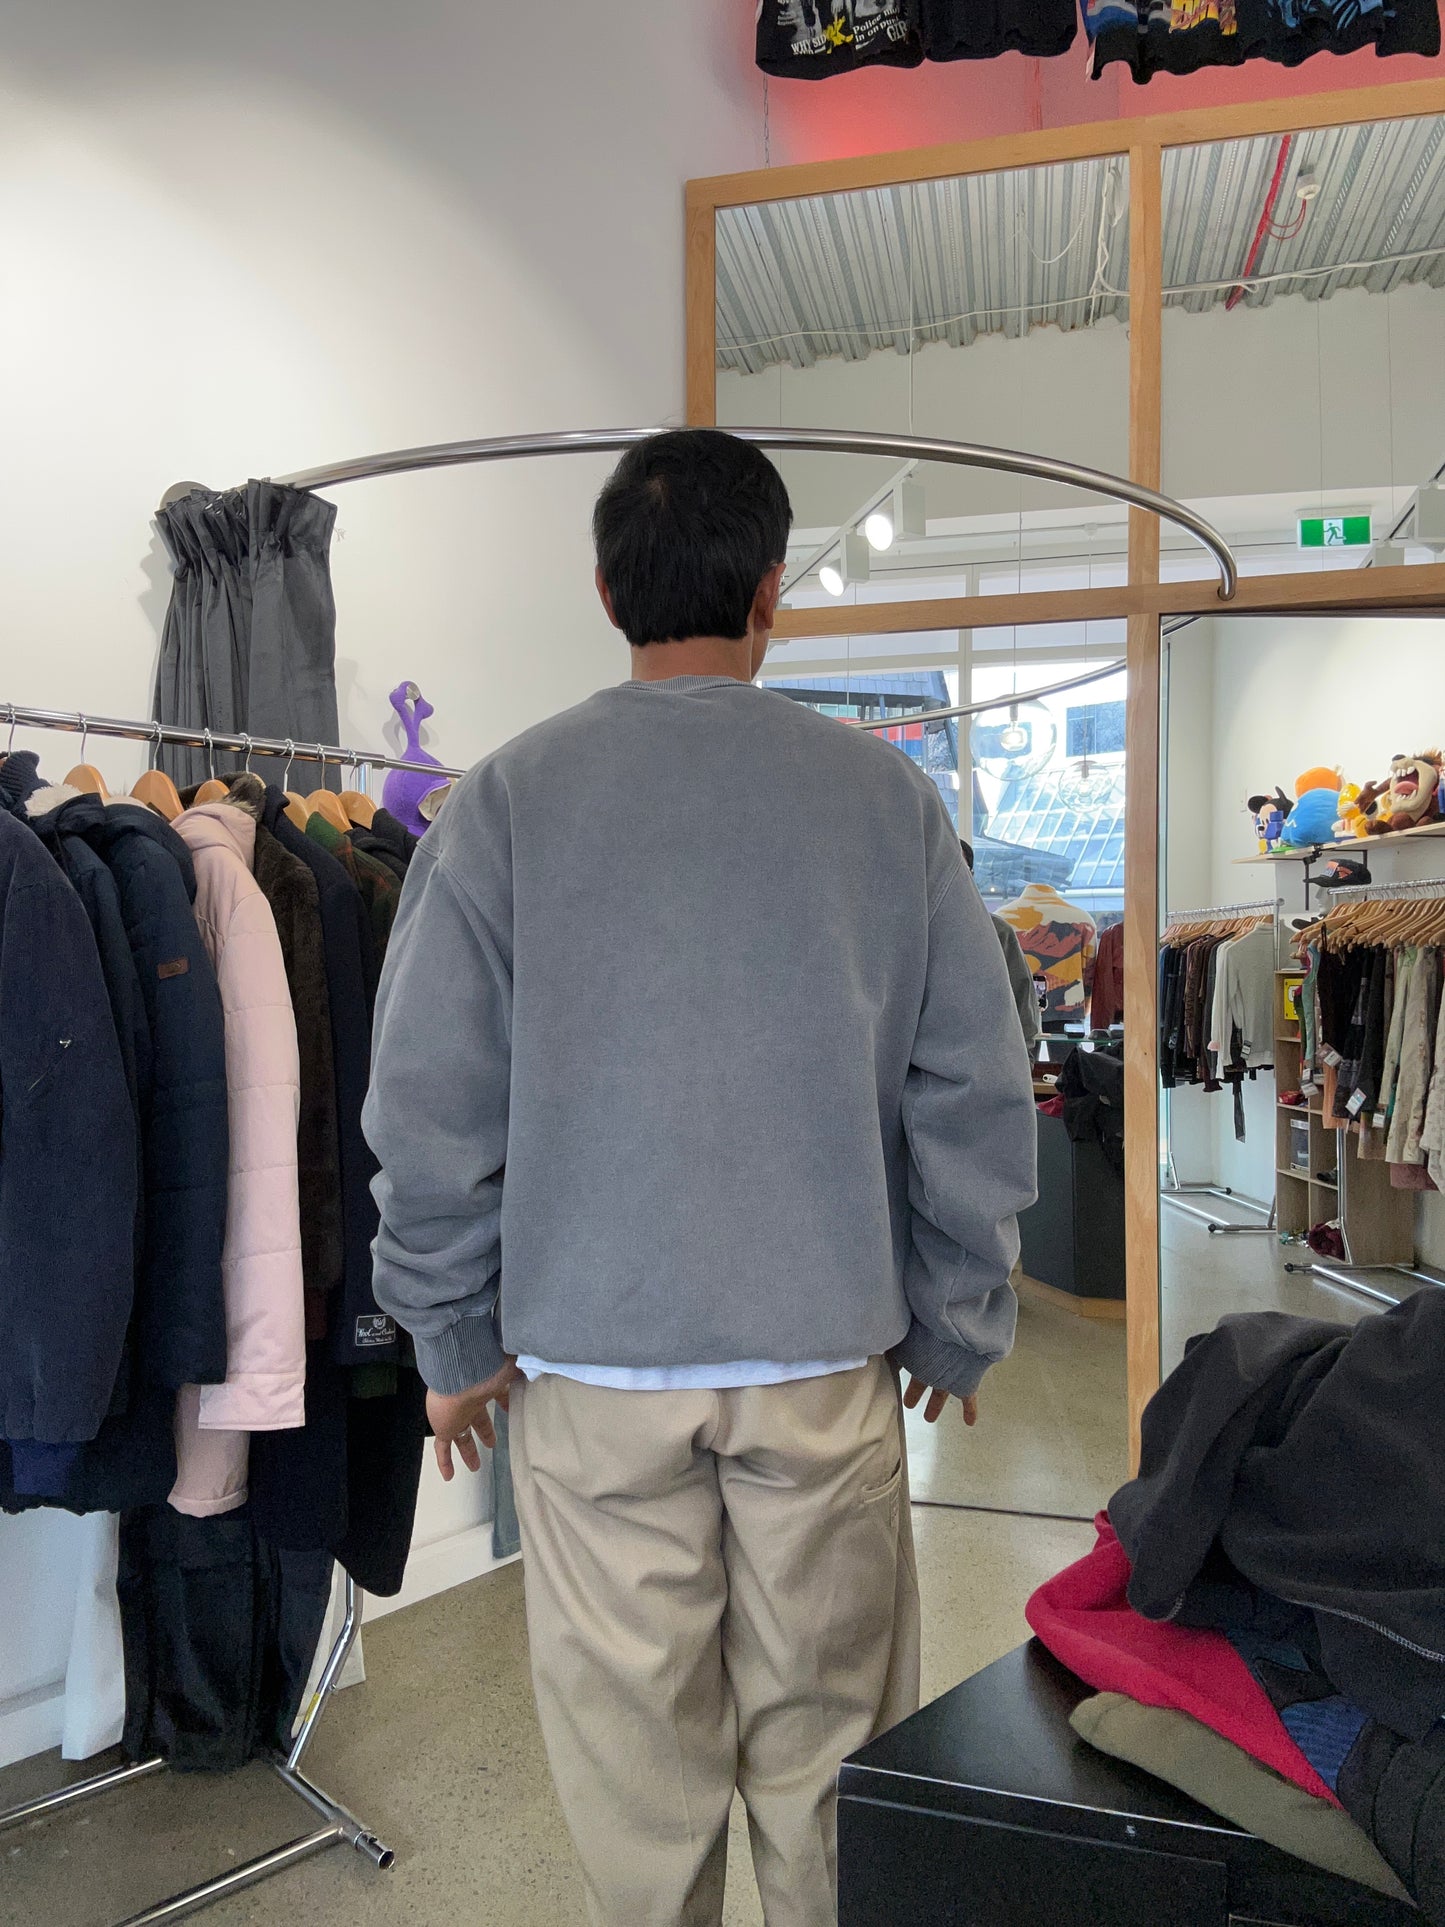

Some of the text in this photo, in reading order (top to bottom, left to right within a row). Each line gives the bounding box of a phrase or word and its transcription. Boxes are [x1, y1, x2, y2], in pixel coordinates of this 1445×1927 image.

[852, 14, 881, 34] Police
[791, 34, 827, 53] WHY SID
[855, 33, 865, 43] in
[867, 25, 879, 36] on
